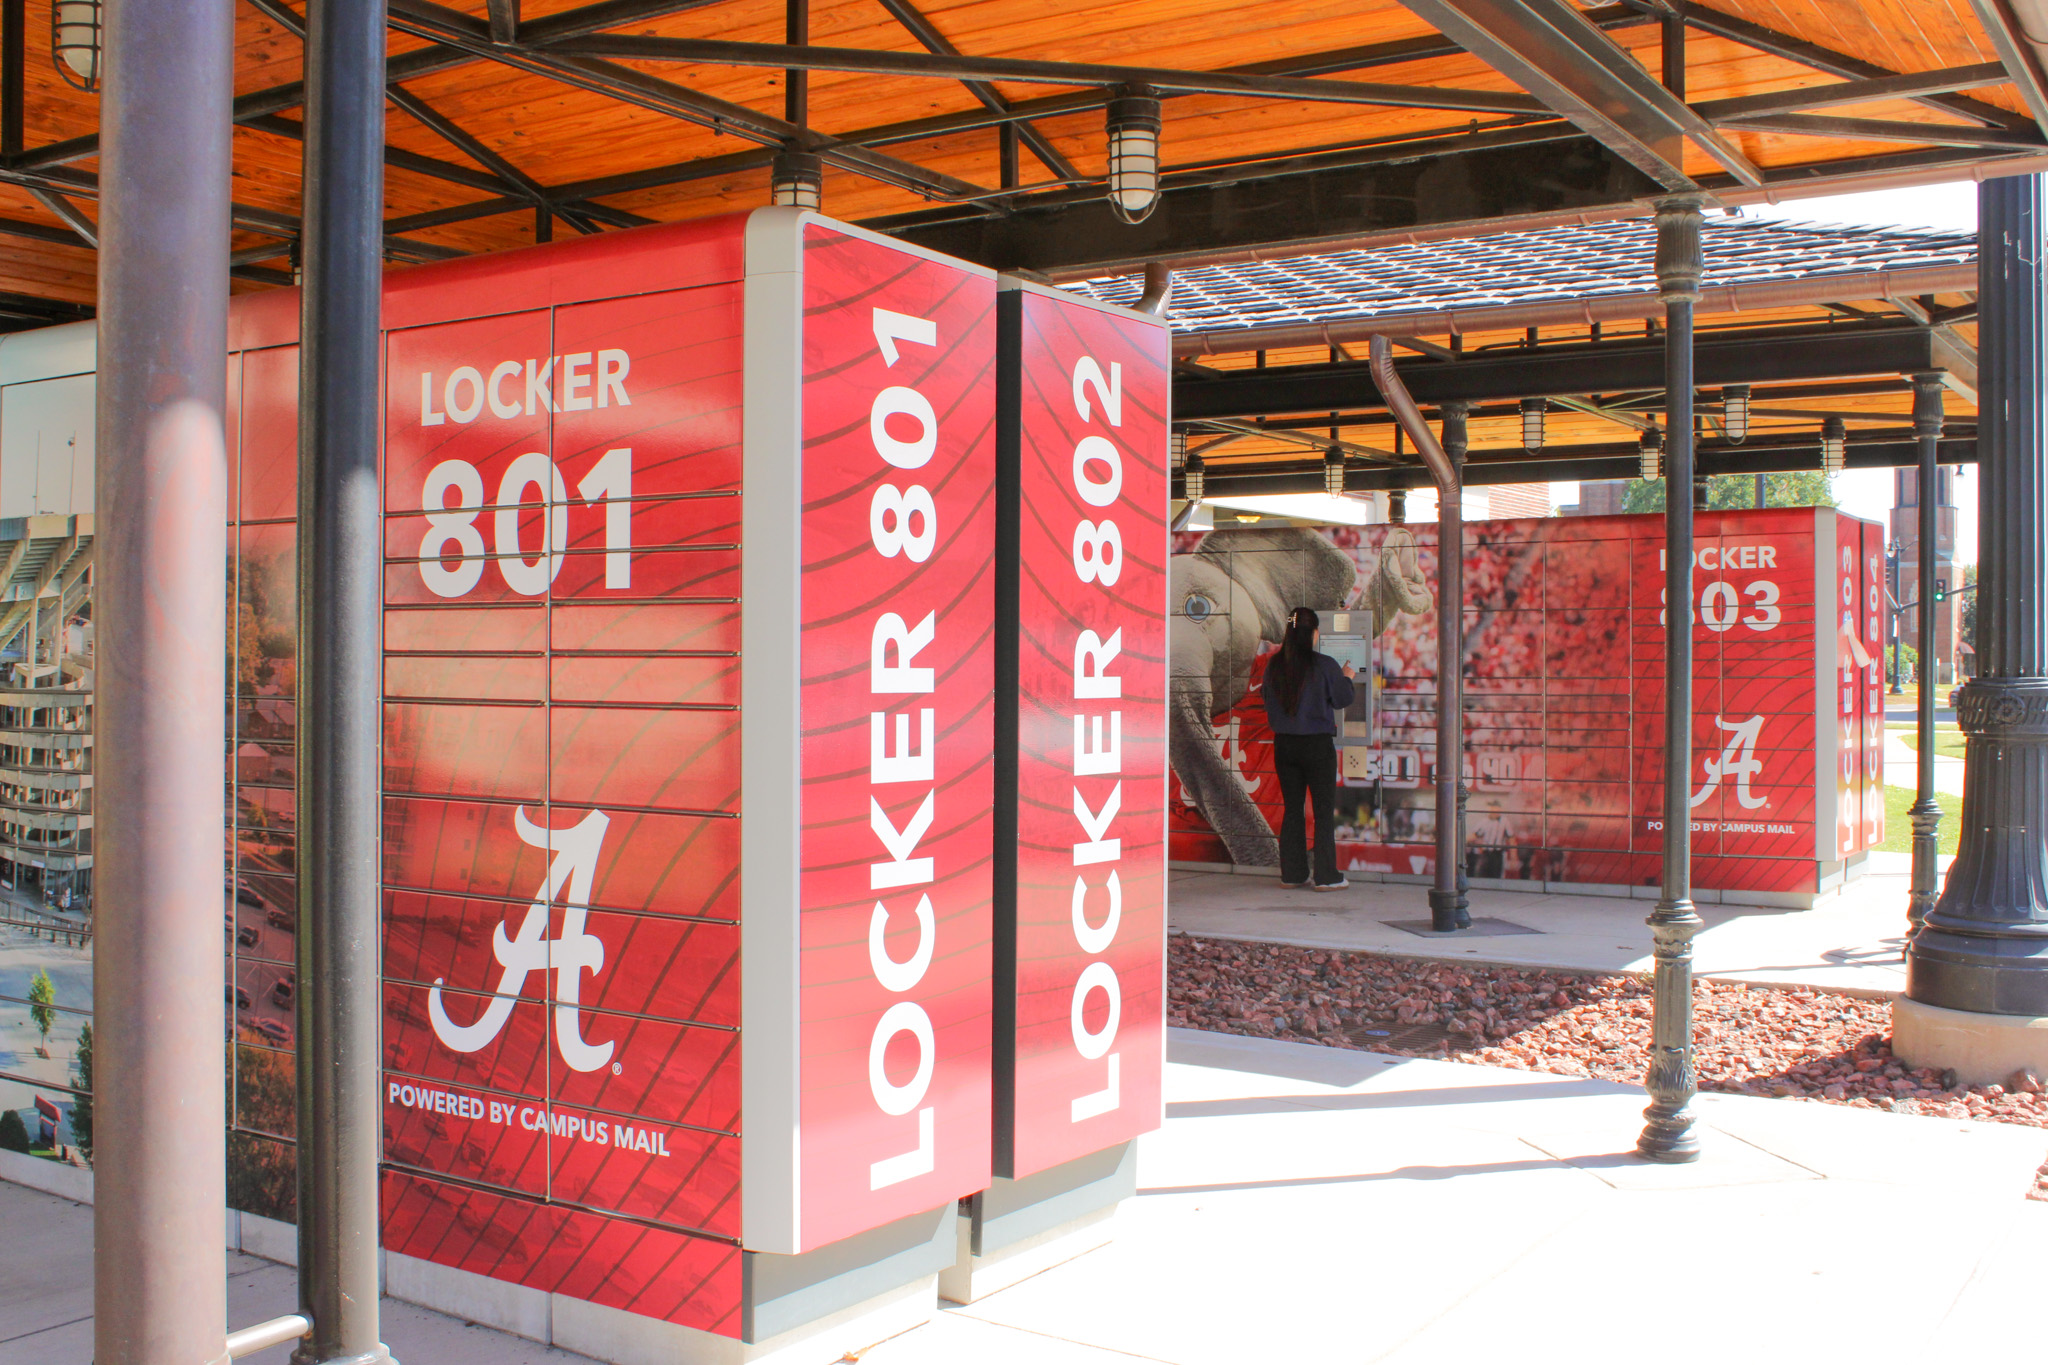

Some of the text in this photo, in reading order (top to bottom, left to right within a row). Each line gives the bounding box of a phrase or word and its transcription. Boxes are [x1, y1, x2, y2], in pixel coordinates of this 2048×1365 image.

[421, 348, 632, 427] LOCKER
[419, 448, 632, 598] 801
[1660, 545, 1777, 571] LCKER
[1660, 580, 1782, 632] 03
[869, 307, 937, 1191] LOCKER 801
[1071, 355, 1122, 1123] LOCKER 802
[1843, 653, 1853, 852] LOCKER
[1868, 553, 1879, 844] LOCKER 804
[1703, 822, 1718, 832] BY
[1719, 822, 1765, 834] CAMPUS
[1767, 824, 1796, 835] MAIL
[428, 805, 615, 1073] A
[389, 1082, 671, 1157] POWERED BY CAMPUS MAIL
